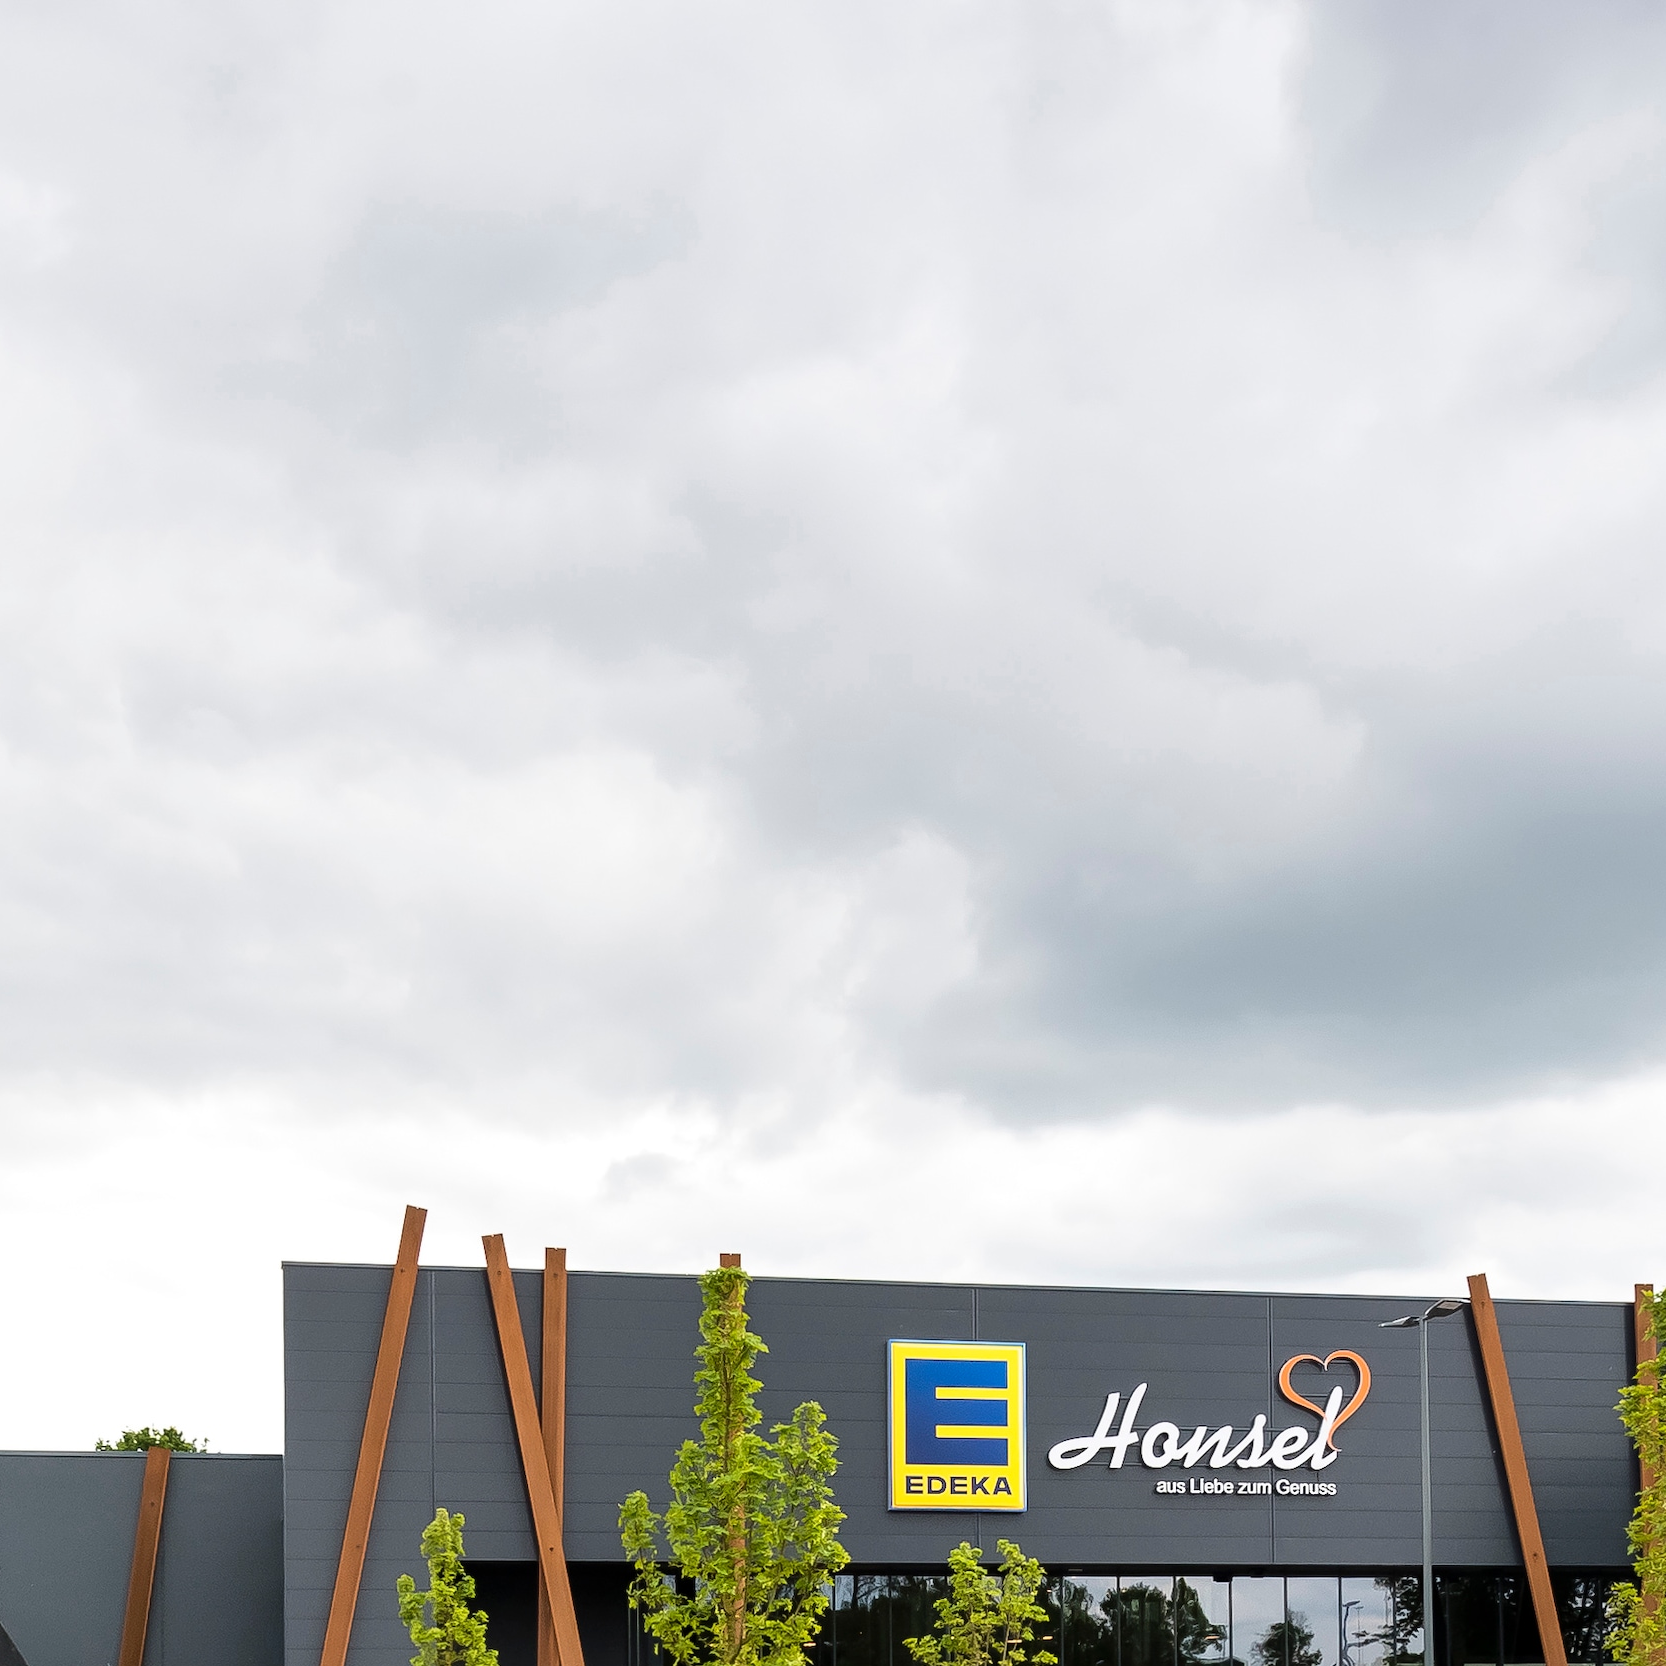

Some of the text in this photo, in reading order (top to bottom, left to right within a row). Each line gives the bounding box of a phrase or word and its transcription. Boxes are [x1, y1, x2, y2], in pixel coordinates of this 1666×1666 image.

[905, 1358, 1008, 1466] E
[1047, 1382, 1343, 1471] Honsel
[905, 1475, 1013, 1496] EDEKA
[1156, 1477, 1338, 1496] aus Liebe zum Genuss
